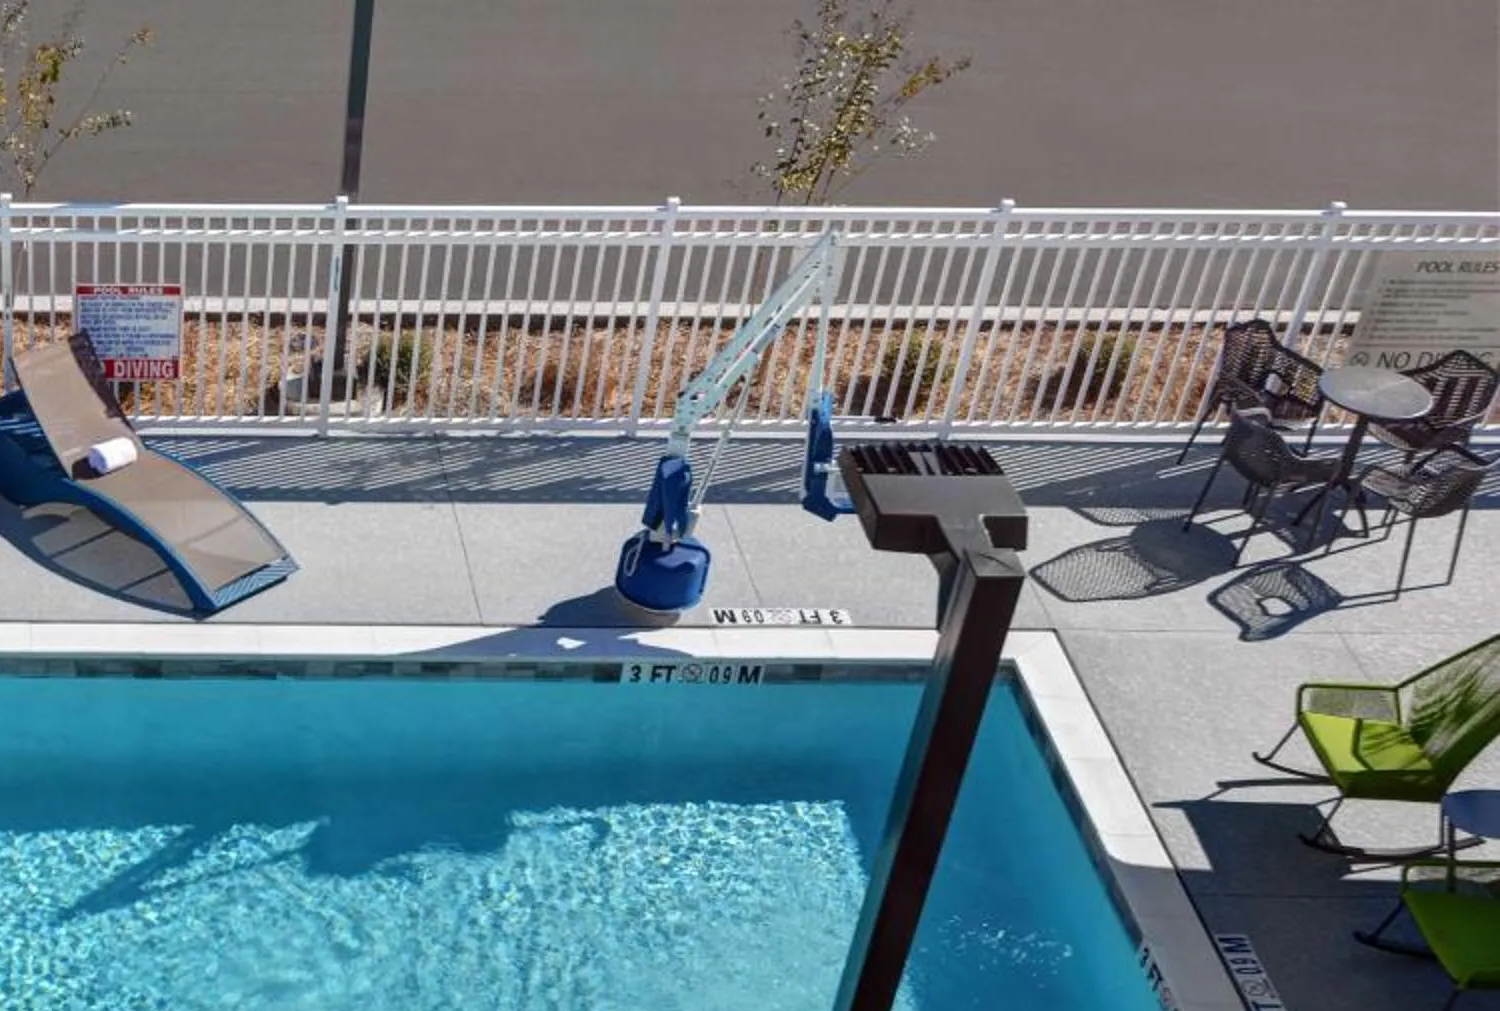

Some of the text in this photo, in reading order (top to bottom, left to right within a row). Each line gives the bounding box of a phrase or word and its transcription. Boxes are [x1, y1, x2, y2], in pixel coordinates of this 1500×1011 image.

[1417, 261, 1500, 273] POOL RULES
[1376, 351, 1411, 369] NO
[113, 362, 174, 377] DIVING
[714, 610, 736, 623] M
[798, 610, 821, 624] FT
[829, 612, 844, 624] 3
[630, 665, 640, 682] 3
[650, 665, 676, 682] FT
[738, 666, 762, 684] M
[1218, 937, 1252, 952] M
[1147, 962, 1164, 992] FT
